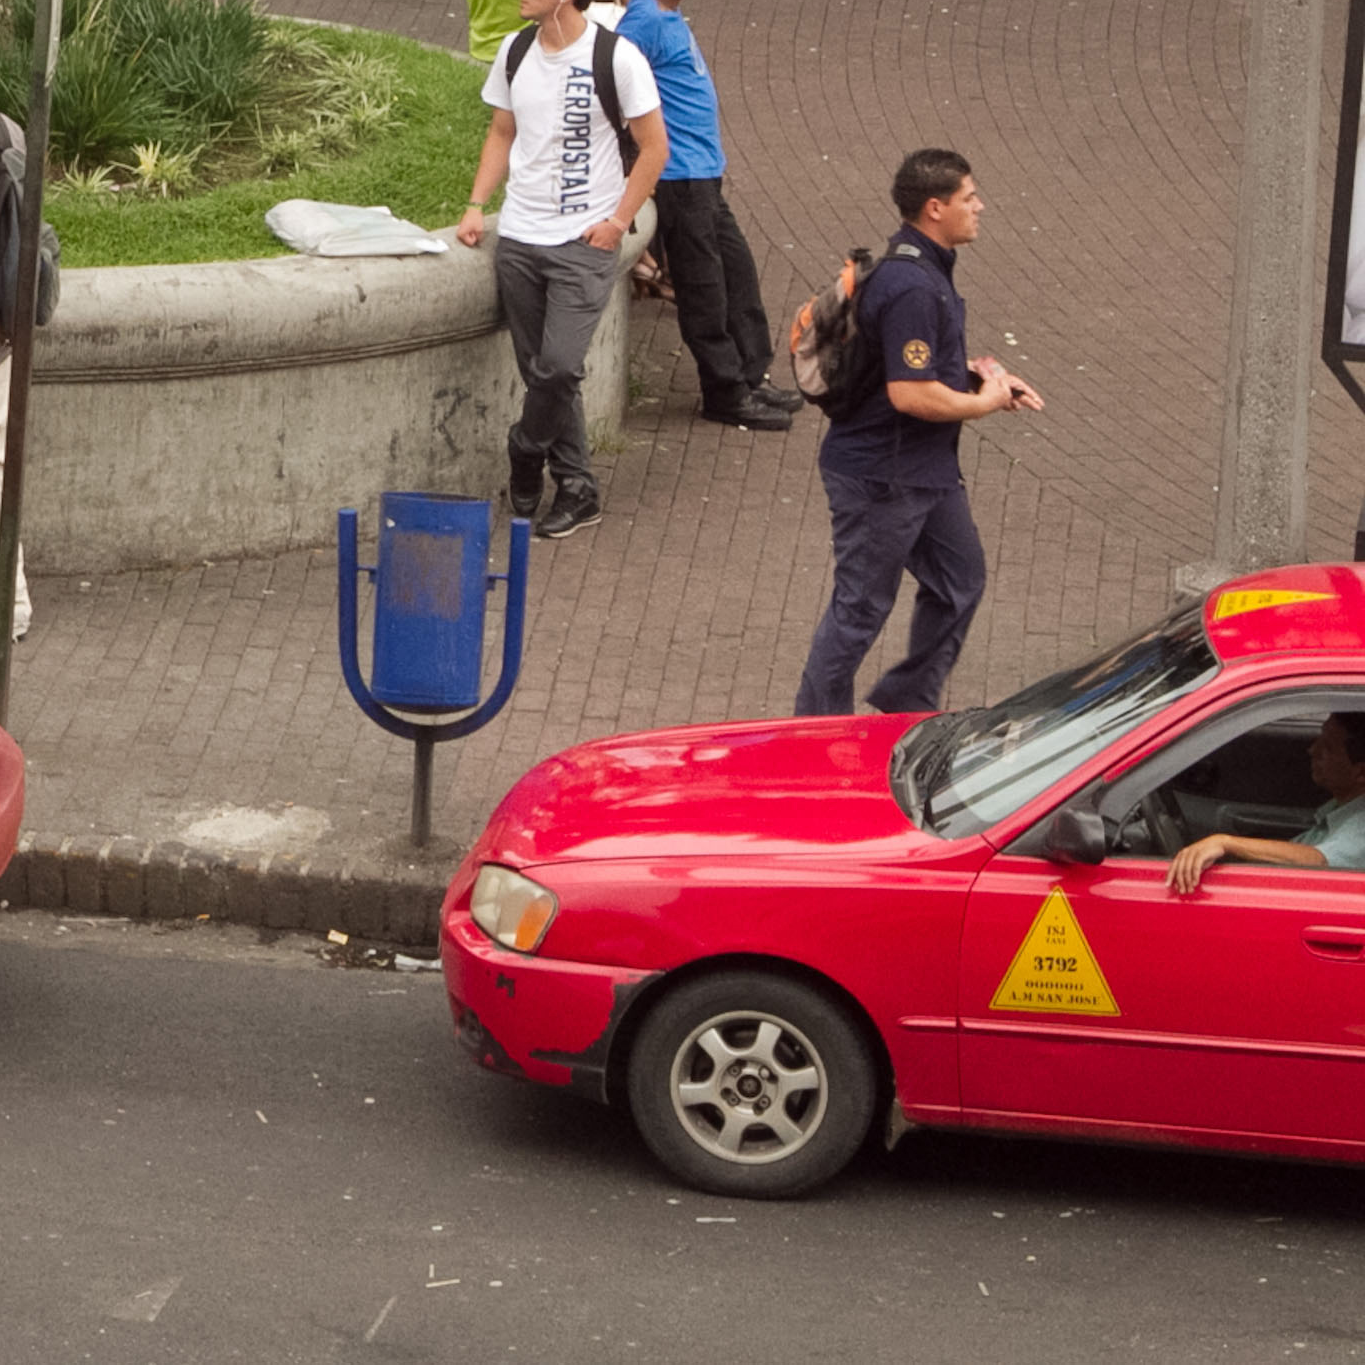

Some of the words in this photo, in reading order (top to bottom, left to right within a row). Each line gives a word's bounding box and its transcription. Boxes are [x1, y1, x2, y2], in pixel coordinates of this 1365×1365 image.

[560, 65, 595, 216] AEROPOSTALE
[1047, 925, 1066, 936] TSJ
[1033, 956, 1077, 973] 3792
[1037, 992, 1063, 1003] SAN
